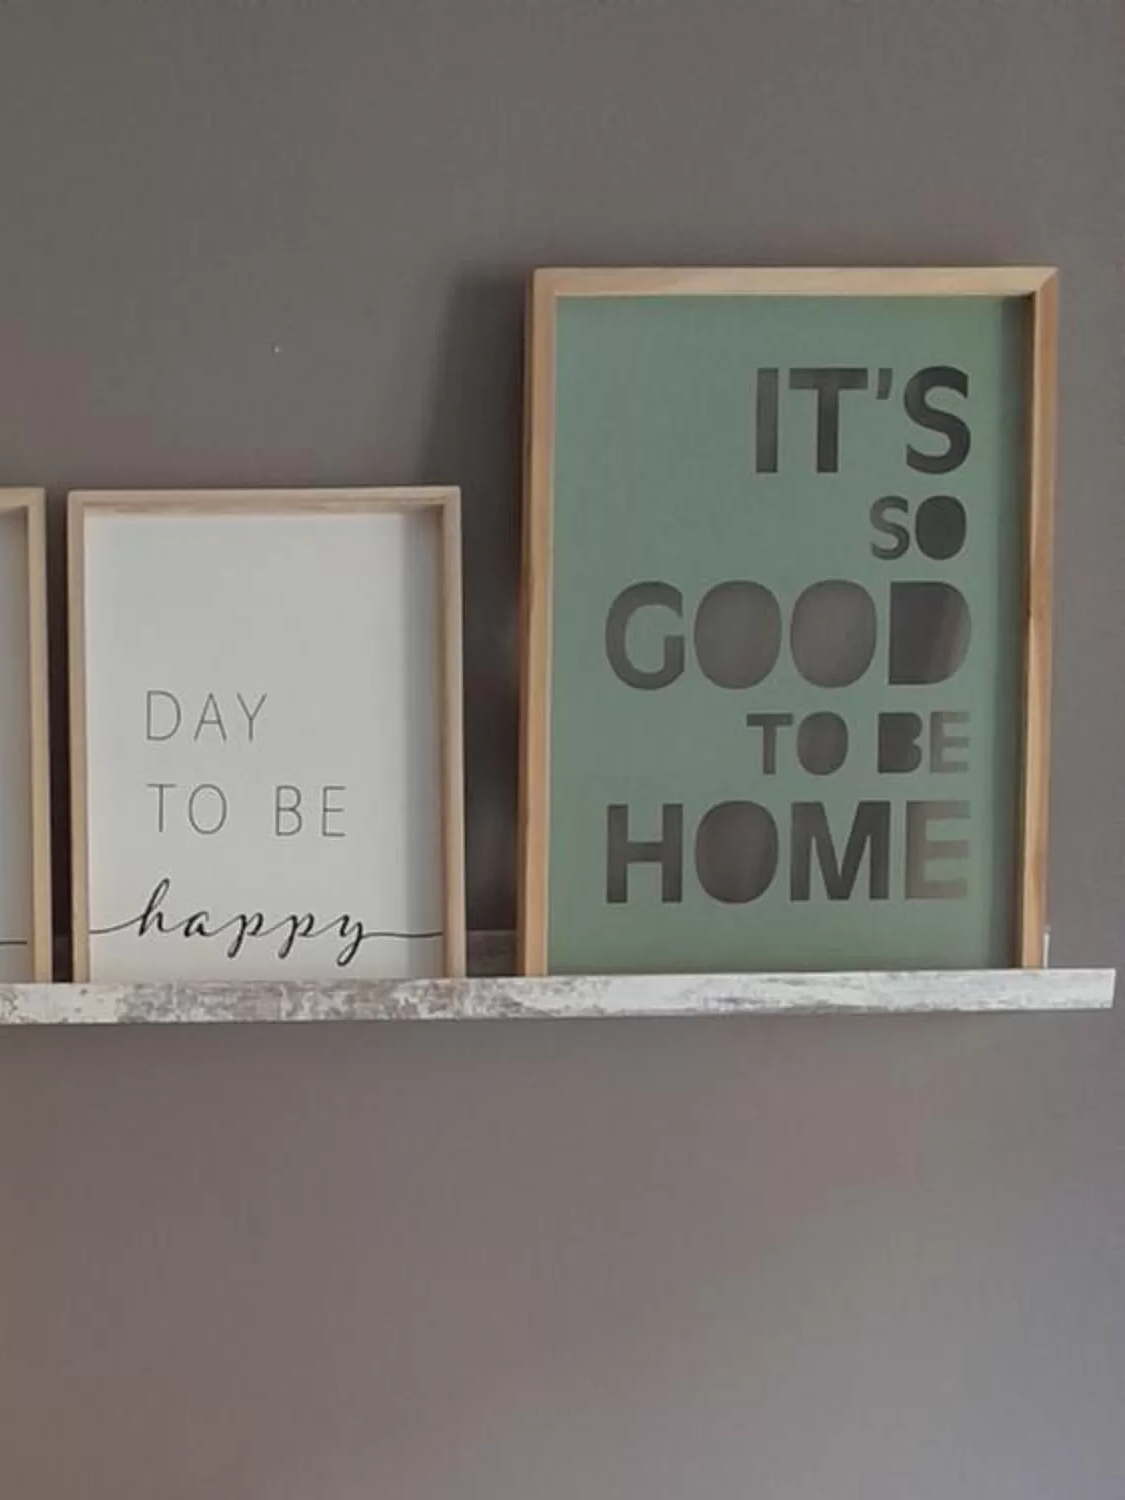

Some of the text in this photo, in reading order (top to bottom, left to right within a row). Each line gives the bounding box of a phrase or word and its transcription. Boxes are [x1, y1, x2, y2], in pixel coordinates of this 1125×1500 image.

[756, 365, 971, 474] IT'S
[869, 495, 966, 560] SO
[605, 579, 972, 690] GOOD
[145, 690, 268, 744] DAY
[746, 711, 971, 775] TO BE
[147, 784, 347, 838] TO BE
[606, 800, 971, 903] HOME
[90, 879, 443, 966] happy
